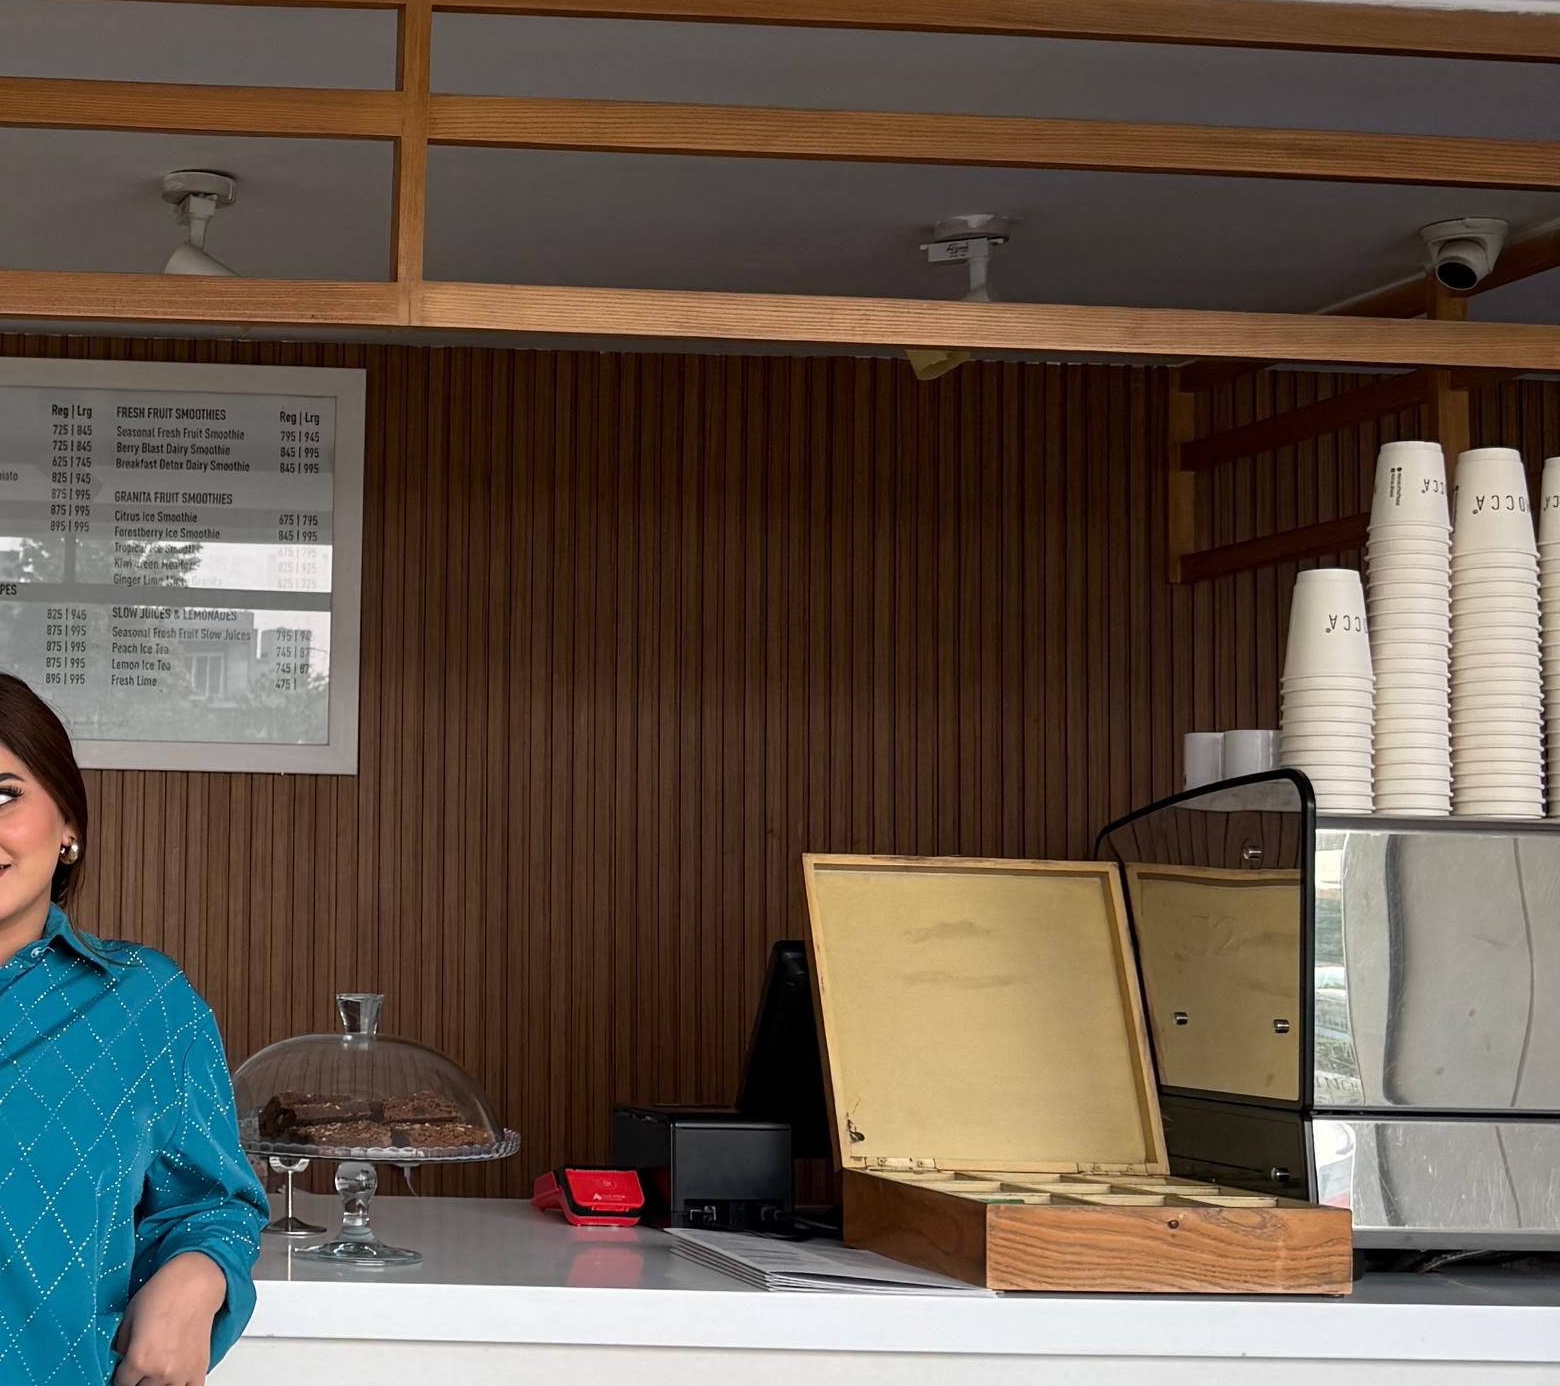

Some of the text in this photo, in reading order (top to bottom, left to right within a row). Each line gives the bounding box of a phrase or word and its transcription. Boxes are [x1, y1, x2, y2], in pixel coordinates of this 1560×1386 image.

[52, 405, 92, 419] Reg Lrg
[117, 406, 226, 420] FRESH FRUIT SMOOTHIES
[280, 411, 320, 426] Reg Lrg
[53, 425, 68, 435] 725
[117, 426, 245, 440] Seasonal Fresh Fruit Smoothie
[281, 432, 320, 442] 795 945
[117, 442, 230, 456] Berry Blast Dairy Smoothie
[305, 448, 319, 458] 995
[116, 458, 249, 472] Breakfast Detox Dairy Smoothie
[304, 464, 319, 474] 995
[115, 491, 232, 505] GRANITA FRUIT SMOOTHIES
[115, 511, 197, 523] Citrus Ice Smoothie
[279, 515, 318, 526] 675 795
[115, 527, 220, 540] Forestberry Ice Smoothie
[114, 575, 140, 587] Ginger
[112, 607, 137, 619] SLOW
[140, 609, 171, 619] JUICES
[183, 610, 237, 621] LEMONADES
[112, 627, 251, 641] Seasonal Fresh Fruit Slow Juices
[112, 644, 169, 655] Peach Ice Tea
[112, 659, 171, 671] Lemon Ice Tea
[111, 676, 157, 687] Fresh Lime
